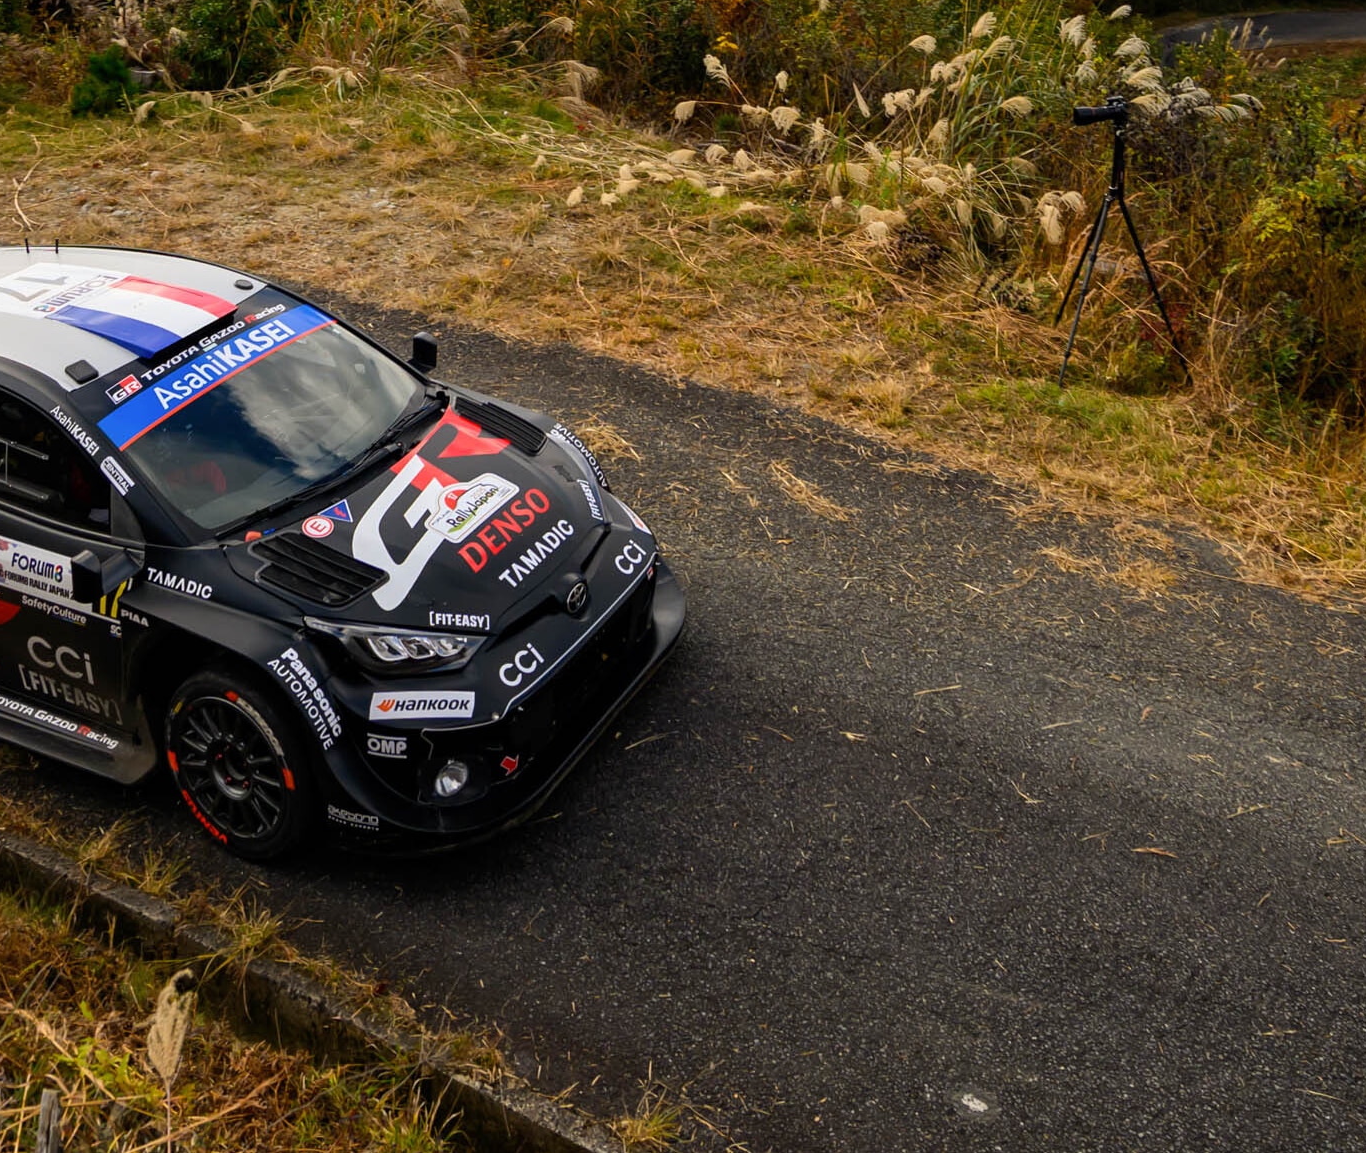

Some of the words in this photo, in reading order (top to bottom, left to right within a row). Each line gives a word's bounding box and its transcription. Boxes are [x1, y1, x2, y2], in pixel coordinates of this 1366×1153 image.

[111, 379, 142, 405] GR
[141, 345, 200, 381] TOYOTA
[199, 322, 246, 348] GAZOO
[244, 303, 286, 324] Racing
[153, 319, 296, 410] AsahiKASEI
[49, 405, 99, 456] AsahiKASEI
[103, 459, 130, 493] CENTRAL
[554, 423, 607, 487] AUTOMOTIVE
[457, 488, 550, 574] DENSO
[499, 519, 575, 588] TAMADIC
[4, 570, 29, 586] FORUM8
[29, 577, 48, 592] RALLY
[49, 584, 70, 599] JAPAN
[11, 552, 63, 583] FORUM8
[147, 567, 213, 599] TAMADIC
[21, 594, 87, 624] SafetyCulture
[121, 609, 149, 627] PIAA
[27, 635, 94, 685] CCi
[499, 642, 545, 687] CCi
[267, 658, 334, 750] AUTOMOTIVE
[281, 647, 342, 737] Panasonic
[35, 709, 77, 732] GAZOO
[77, 724, 119, 750] Racing
[367, 738, 407, 755] OMP
